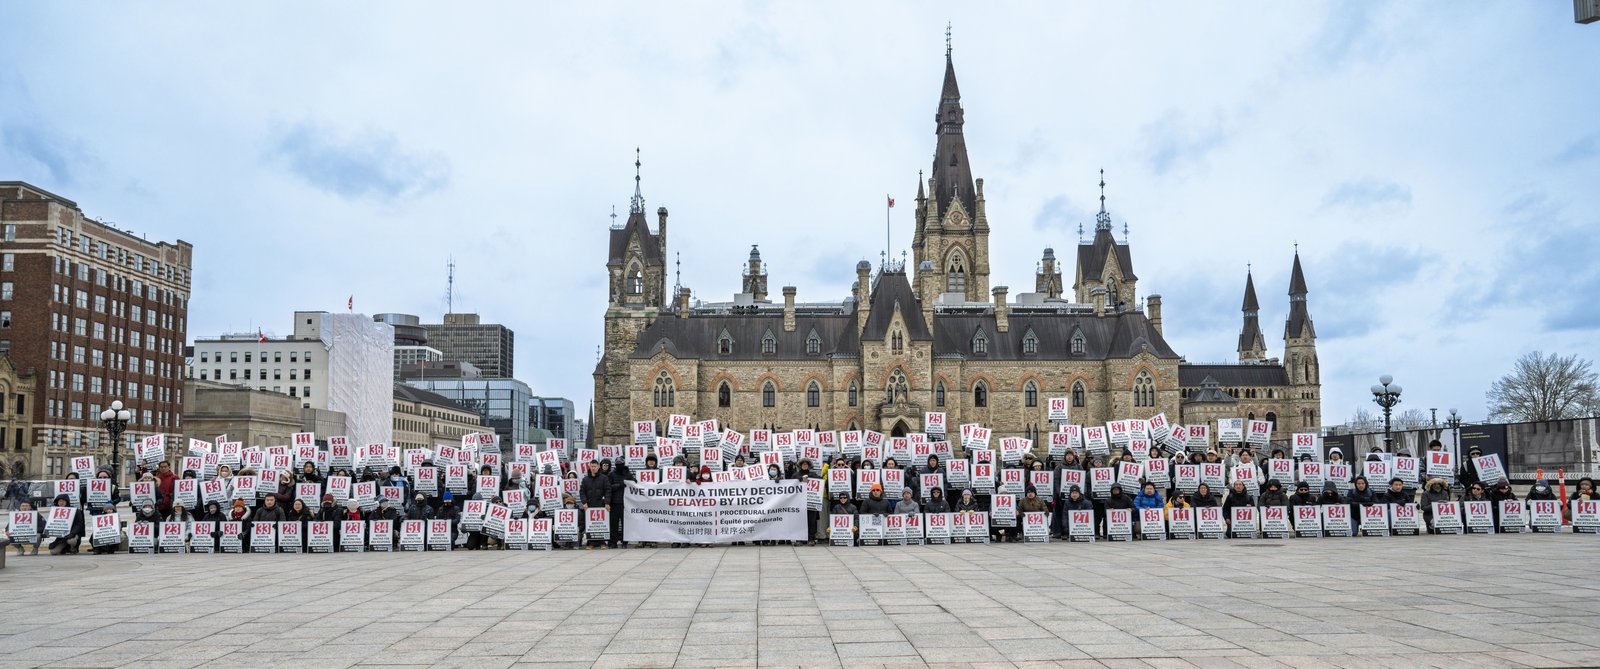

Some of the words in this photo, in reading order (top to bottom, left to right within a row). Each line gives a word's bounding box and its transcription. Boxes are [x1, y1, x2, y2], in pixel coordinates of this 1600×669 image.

[1052, 400, 1064, 410] 43
[674, 416, 686, 426] 27
[930, 414, 942, 423] 25
[638, 423, 652, 432] 28
[686, 426, 700, 436] 34
[1112, 422, 1126, 432] 37
[1130, 421, 1144, 431] 38
[1253, 422, 1268, 433] 19
[754, 431, 767, 441] 15
[797, 431, 810, 441] 20
[845, 432, 858, 442] 32
[974, 428, 986, 439] 31
[1088, 429, 1102, 439] 25
[1190, 427, 1205, 437] 31
[147, 436, 160, 447] 25
[480, 434, 493, 444] 34
[777, 434, 790, 445] 53
[819, 433, 832, 443] 18
[867, 433, 881, 444] 39
[1054, 434, 1067, 444] 43
[1298, 435, 1312, 446] 33
[224, 444, 237, 454] 68
[370, 444, 383, 455] 36
[894, 439, 907, 449] 42
[916, 444, 929, 454] 37
[935, 443, 948, 453] 23
[1004, 439, 1017, 450] 30
[1133, 440, 1146, 451] 32
[300, 447, 314, 458] 25
[334, 445, 347, 456] 37
[440, 447, 454, 458] 53
[520, 445, 532, 456] 23
[602, 447, 613, 457] 39
[630, 448, 643, 458] 31
[660, 446, 673, 457] 19
[705, 450, 718, 460] 40
[805, 448, 818, 458] 54
[866, 448, 878, 458] 23
[207, 454, 218, 464] 30
[275, 456, 288, 466] 81
[412, 454, 425, 465] 55
[484, 455, 497, 465] 22
[541, 452, 554, 463] 22
[978, 452, 992, 461] 35
[1438, 454, 1444, 464] 7
[187, 458, 201, 469] 29
[951, 461, 964, 471] 25
[1150, 460, 1164, 471] 19
[1274, 461, 1289, 472] 26
[1370, 463, 1385, 474] 28
[1398, 458, 1414, 470] 30
[1480, 457, 1496, 469] 28
[419, 469, 432, 479] 29
[450, 466, 463, 477] 29
[668, 468, 682, 479] 38
[734, 469, 746, 480] 20
[748, 465, 763, 477] 90
[980, 466, 986, 476] 8
[1096, 469, 1110, 480] 39
[1124, 464, 1138, 475] 16
[1180, 466, 1194, 477] 28
[1206, 465, 1220, 476] 35
[1236, 468, 1252, 479] 37
[1304, 464, 1320, 475] 32
[1330, 466, 1346, 477] 40
[263, 471, 276, 481] 19
[640, 472, 655, 482] 31
[833, 470, 846, 481] 33
[862, 471, 876, 482] 70
[886, 470, 900, 481] 31
[925, 475, 938, 486] 46
[1006, 470, 1020, 481] 19
[1035, 473, 1049, 484] 16
[1067, 472, 1080, 482] 19
[60, 481, 74, 492] 36
[92, 480, 106, 491] 27
[180, 480, 193, 492] 34
[239, 477, 252, 488] 13
[332, 479, 346, 489] 40
[482, 477, 495, 487] 23
[540, 476, 553, 487] 19
[565, 480, 578, 491] 36
[136, 484, 150, 494] 24
[206, 482, 221, 493] 33
[301, 485, 316, 495] 39
[358, 484, 371, 495] 36
[385, 488, 399, 498] 32
[629, 487, 645, 495] WE
[648, 488, 696, 497] DEMAND
[708, 488, 747, 496] TIMELY
[751, 485, 802, 495] DECISION
[508, 492, 522, 502] 43
[544, 488, 558, 499] 39
[468, 502, 482, 512] 23
[669, 498, 716, 506] DELAYED
[720, 498, 733, 506] BY
[737, 497, 763, 505] IRCC
[997, 496, 1011, 507] 12
[1329, 506, 1345, 518] 34
[1367, 506, 1382, 518] 22
[1398, 505, 1413, 517] 38
[1439, 504, 1455, 515] 21
[1471, 503, 1487, 515] 20
[1506, 502, 1520, 514] 22
[1537, 502, 1554, 513] 18
[1580, 502, 1596, 514] 14
[16, 513, 32, 524] 22
[55, 508, 70, 519] 13
[492, 507, 507, 520] 22
[560, 512, 574, 522] 65
[591, 510, 604, 521] 41
[1028, 514, 1043, 524] 32
[1074, 512, 1088, 523] 27
[1112, 512, 1126, 522] 40
[1145, 511, 1160, 522] 35
[1174, 510, 1189, 520] 11
[1202, 509, 1217, 520] 30
[1237, 509, 1251, 520] 37
[1266, 508, 1282, 520] 22
[1300, 508, 1315, 519] 32
[98, 516, 113, 528] 41
[743, 516, 782, 525] procédurale
[835, 516, 849, 528] 20
[887, 516, 902, 527] 18
[906, 515, 918, 526] 27
[931, 515, 945, 526] 36
[970, 514, 984, 525] 30
[134, 524, 149, 535] 27
[166, 524, 180, 535] 23
[196, 524, 210, 534] 39
[225, 524, 237, 534] 34
[257, 524, 270, 535] 33
[283, 524, 297, 535] 28
[314, 523, 328, 534] 34
[346, 522, 360, 533] 23
[375, 522, 388, 533] 34
[407, 522, 420, 533] 51
[433, 522, 446, 533] 55
[509, 521, 522, 532] 42
[534, 521, 547, 531] 31
